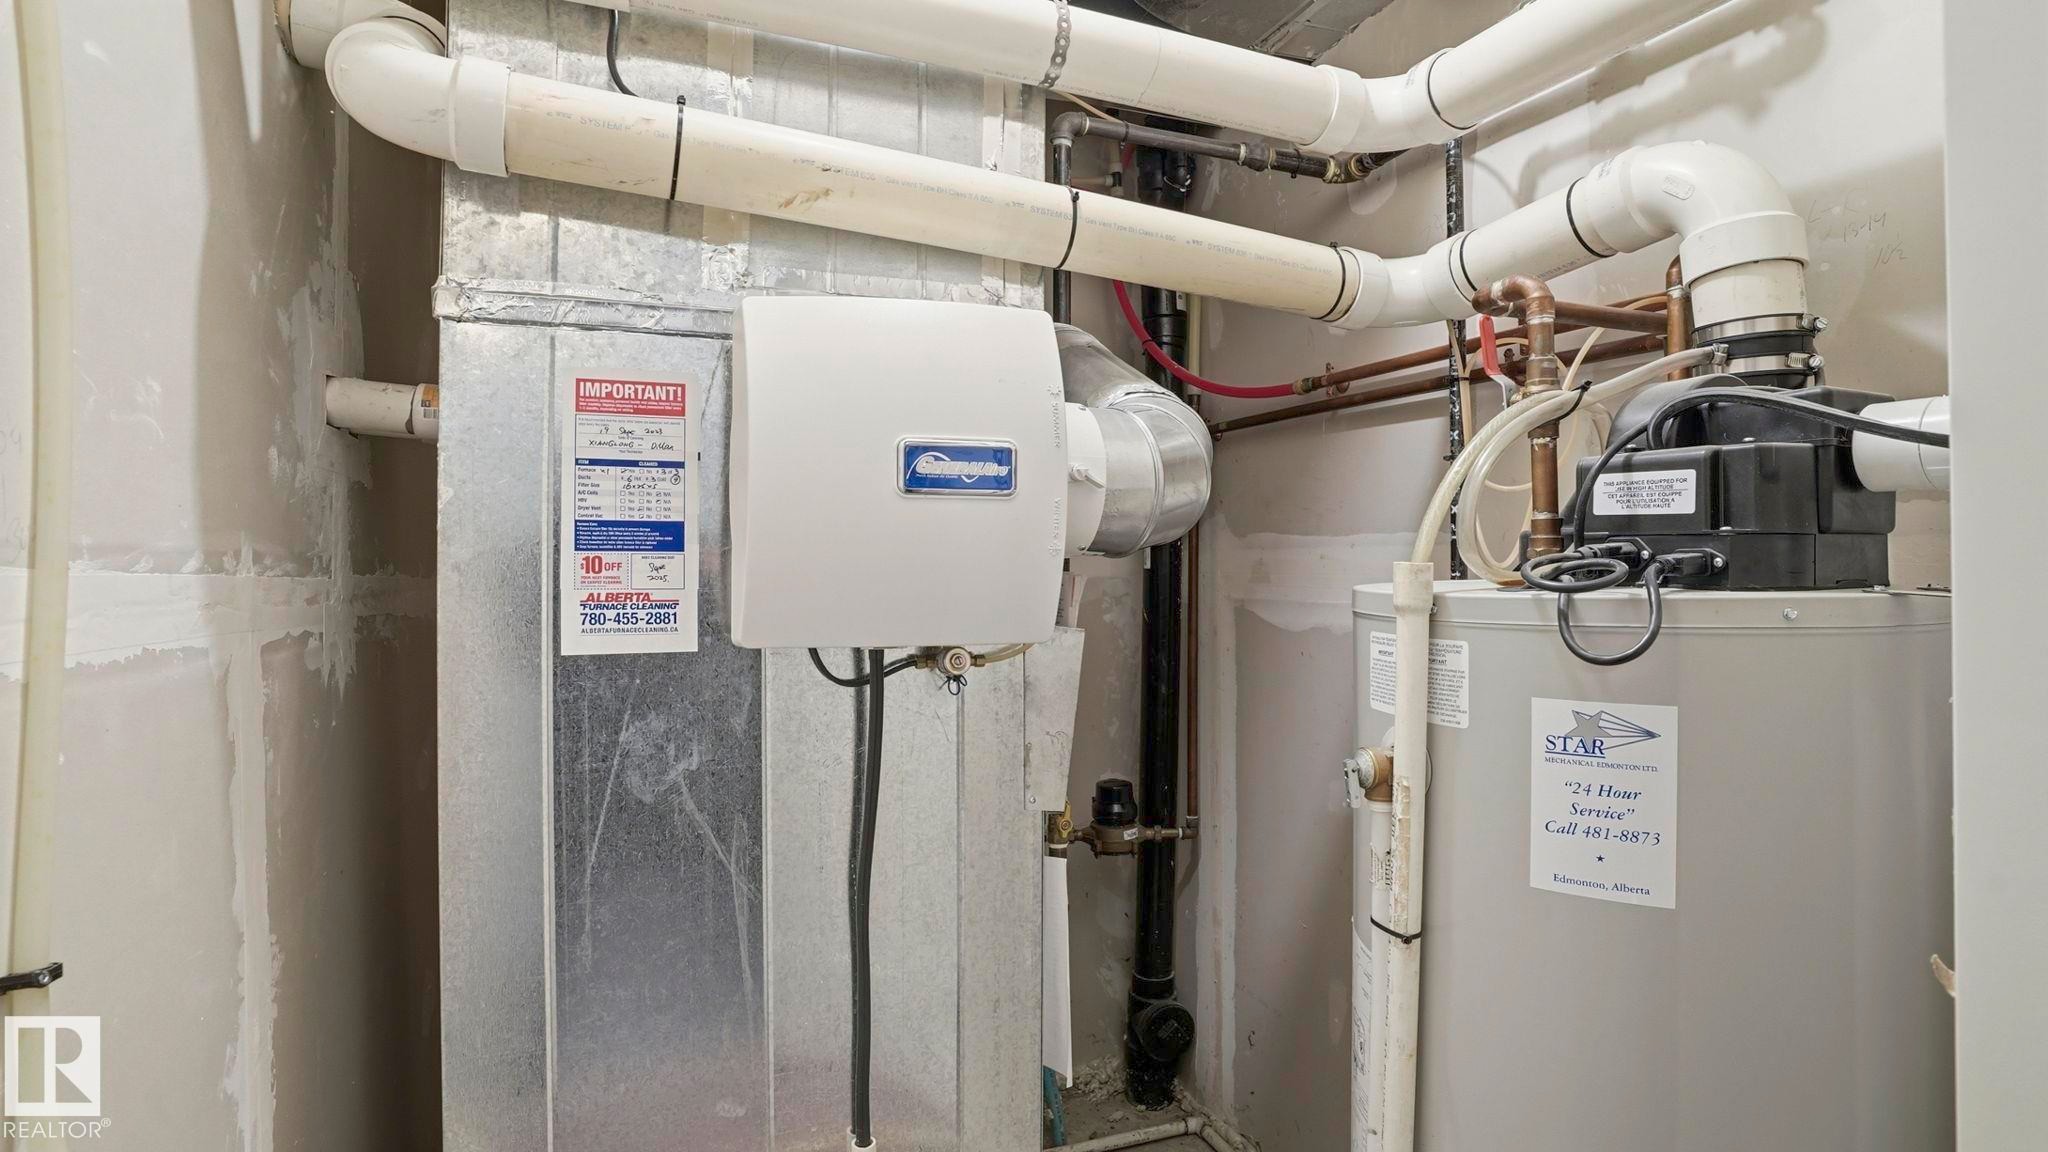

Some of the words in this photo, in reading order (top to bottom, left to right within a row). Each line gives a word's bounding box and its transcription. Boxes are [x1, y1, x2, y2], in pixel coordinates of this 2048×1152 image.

[579, 382, 682, 401] IMPORTANT!
[580, 555, 603, 574] $10
[604, 562, 623, 571] OFF
[585, 593, 651, 602] ALBERTA
[580, 603, 629, 611] FURNACE
[630, 603, 679, 611] CLEANING
[580, 612, 678, 626] 780-455-2881
[1544, 733, 1606, 756] STAR
[1544, 756, 1595, 768] MECHANICAL
[1597, 761, 1641, 772] EDMONTON
[1642, 764, 1658, 773] LTD.
[1597, 784, 1642, 801] Hour
[1545, 819, 1578, 836] Call
[1582, 826, 1661, 847] 481-8873
[1553, 873, 1609, 891] Edmonton,
[1611, 882, 1650, 896] Alberta
